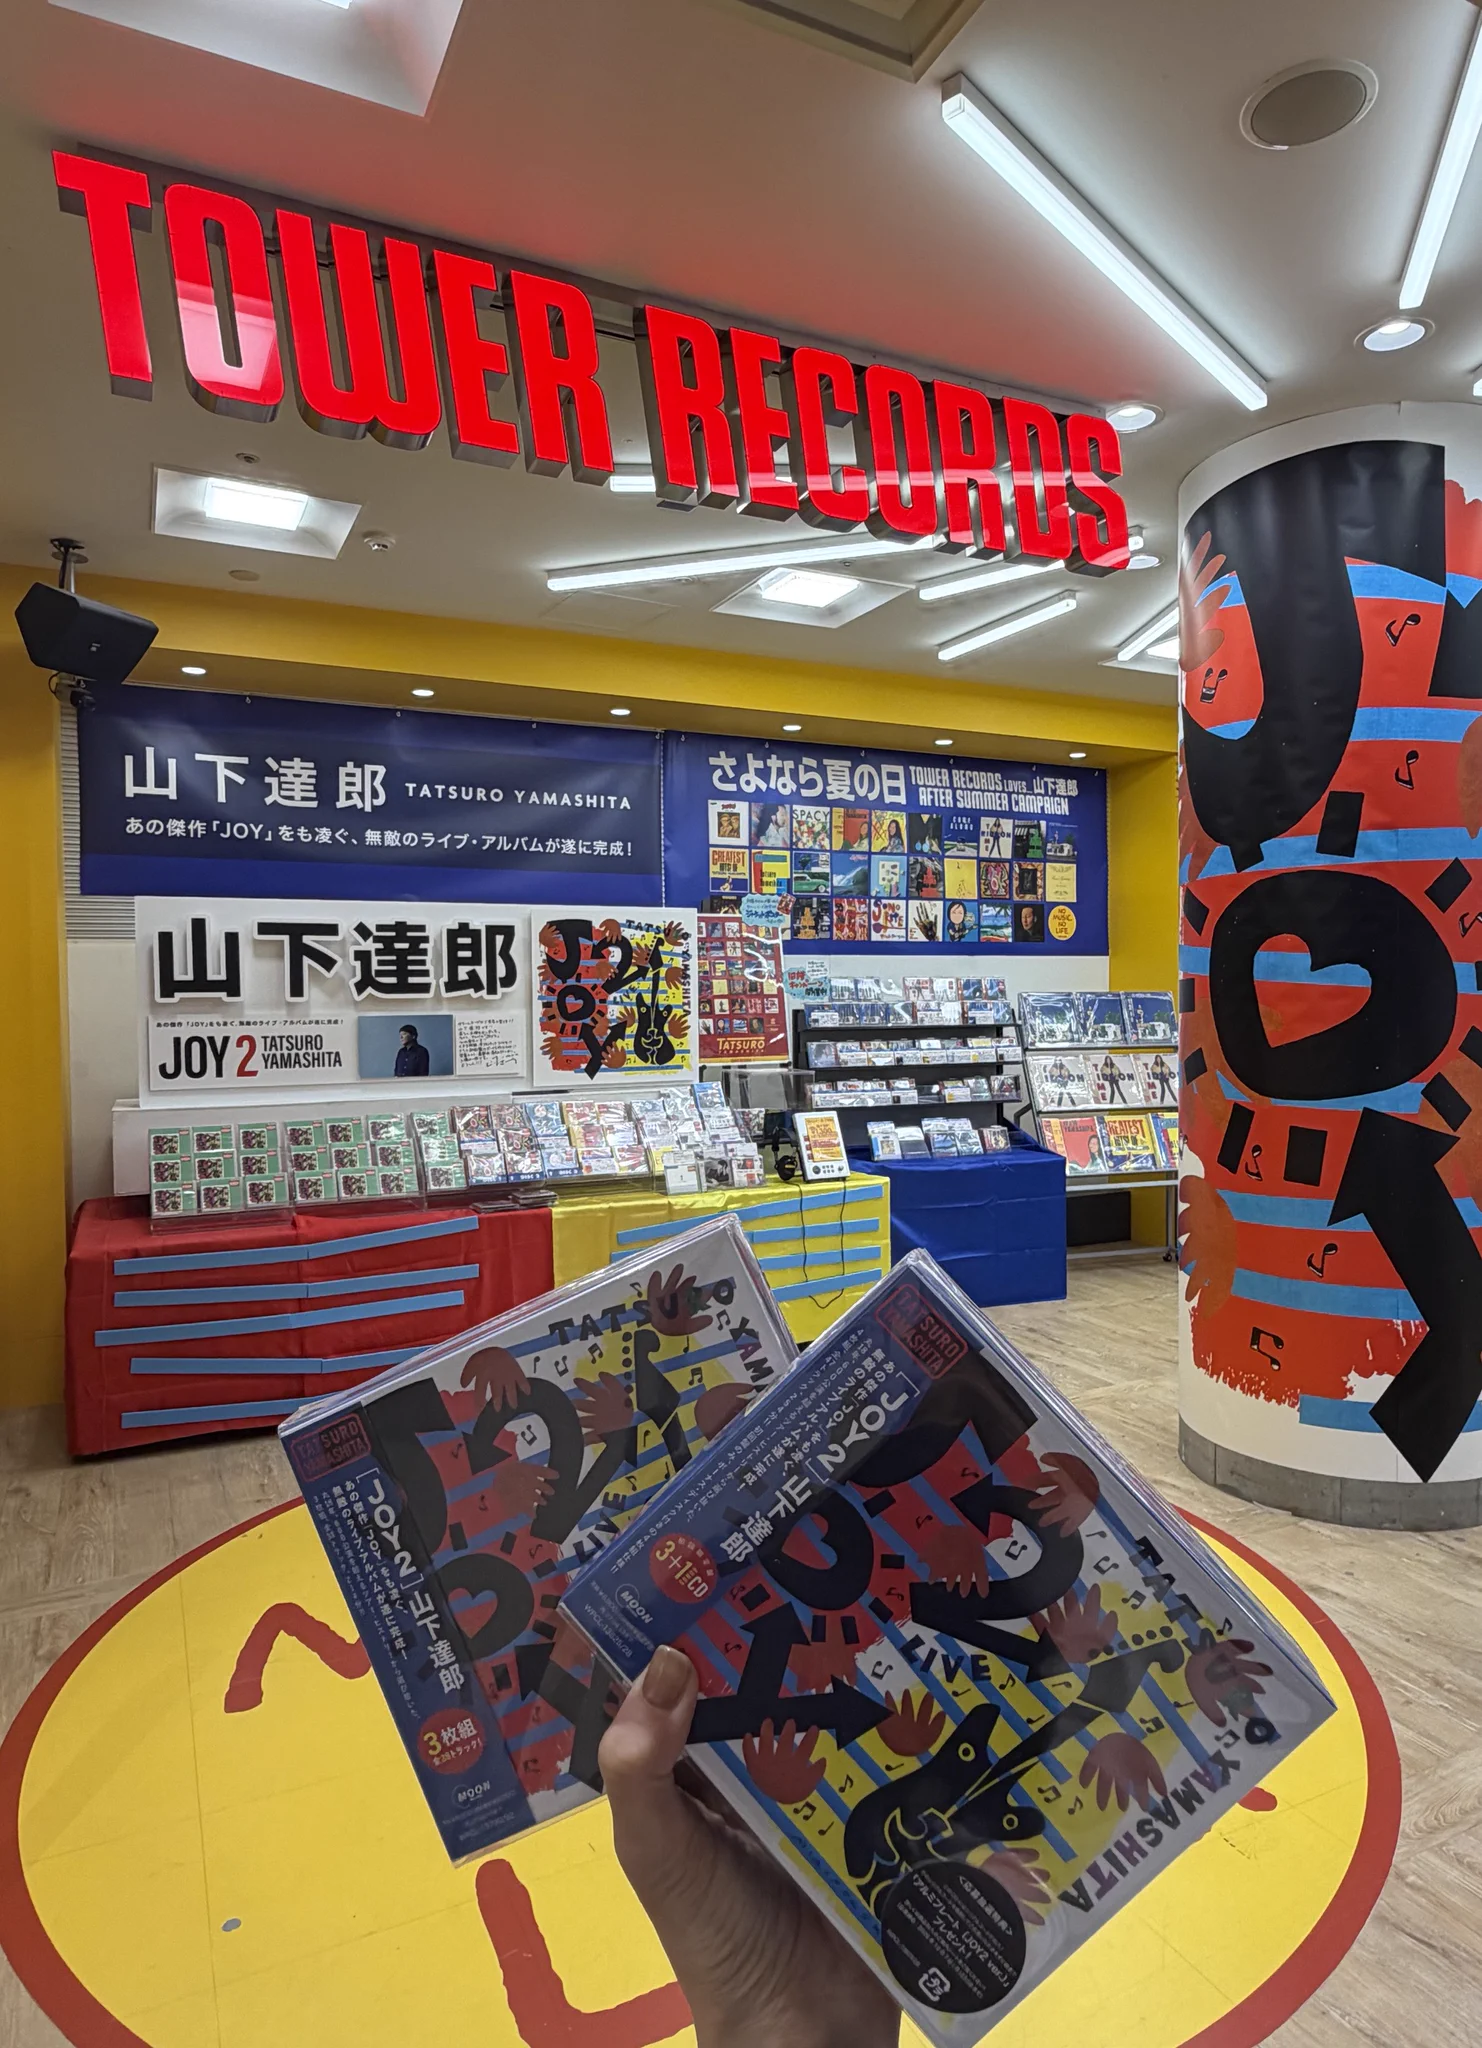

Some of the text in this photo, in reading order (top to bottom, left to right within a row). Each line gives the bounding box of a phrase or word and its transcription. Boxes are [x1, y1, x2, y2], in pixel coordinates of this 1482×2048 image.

[52, 150, 1130, 569] TOWER RECORDS
[124, 746, 632, 812] 山下達郎 TATSURO YAMASHITA
[709, 751, 907, 805] さよなら夏の日
[909, 766, 950, 787] TOWER
[952, 769, 1003, 791] RECORDS
[1033, 776, 1079, 797] 山下達郎
[792, 808, 830, 822] SPACY
[919, 787, 1070, 816] AFTER SUMMER CAMPAIGN
[711, 850, 746, 866] GREATEST
[1055, 927, 1068, 935] LIFE
[157, 917, 517, 999] 山下達郎
[158, 1034, 260, 1080] JOY 2
[261, 1034, 324, 1052] TATSURO
[261, 1051, 343, 1070] YAMASHITA
[716, 1036, 765, 1050] TATSURO
[652, 1537, 693, 1581] 3+1
[685, 1574, 710, 1600] CD
[619, 1588, 654, 1625] MOON
[899, 1634, 993, 1683] LIVE
[420, 1716, 478, 1757] 3枚組
[454, 1778, 492, 1803] MOON
[1057, 1748, 1241, 1913] YAMASHITA
